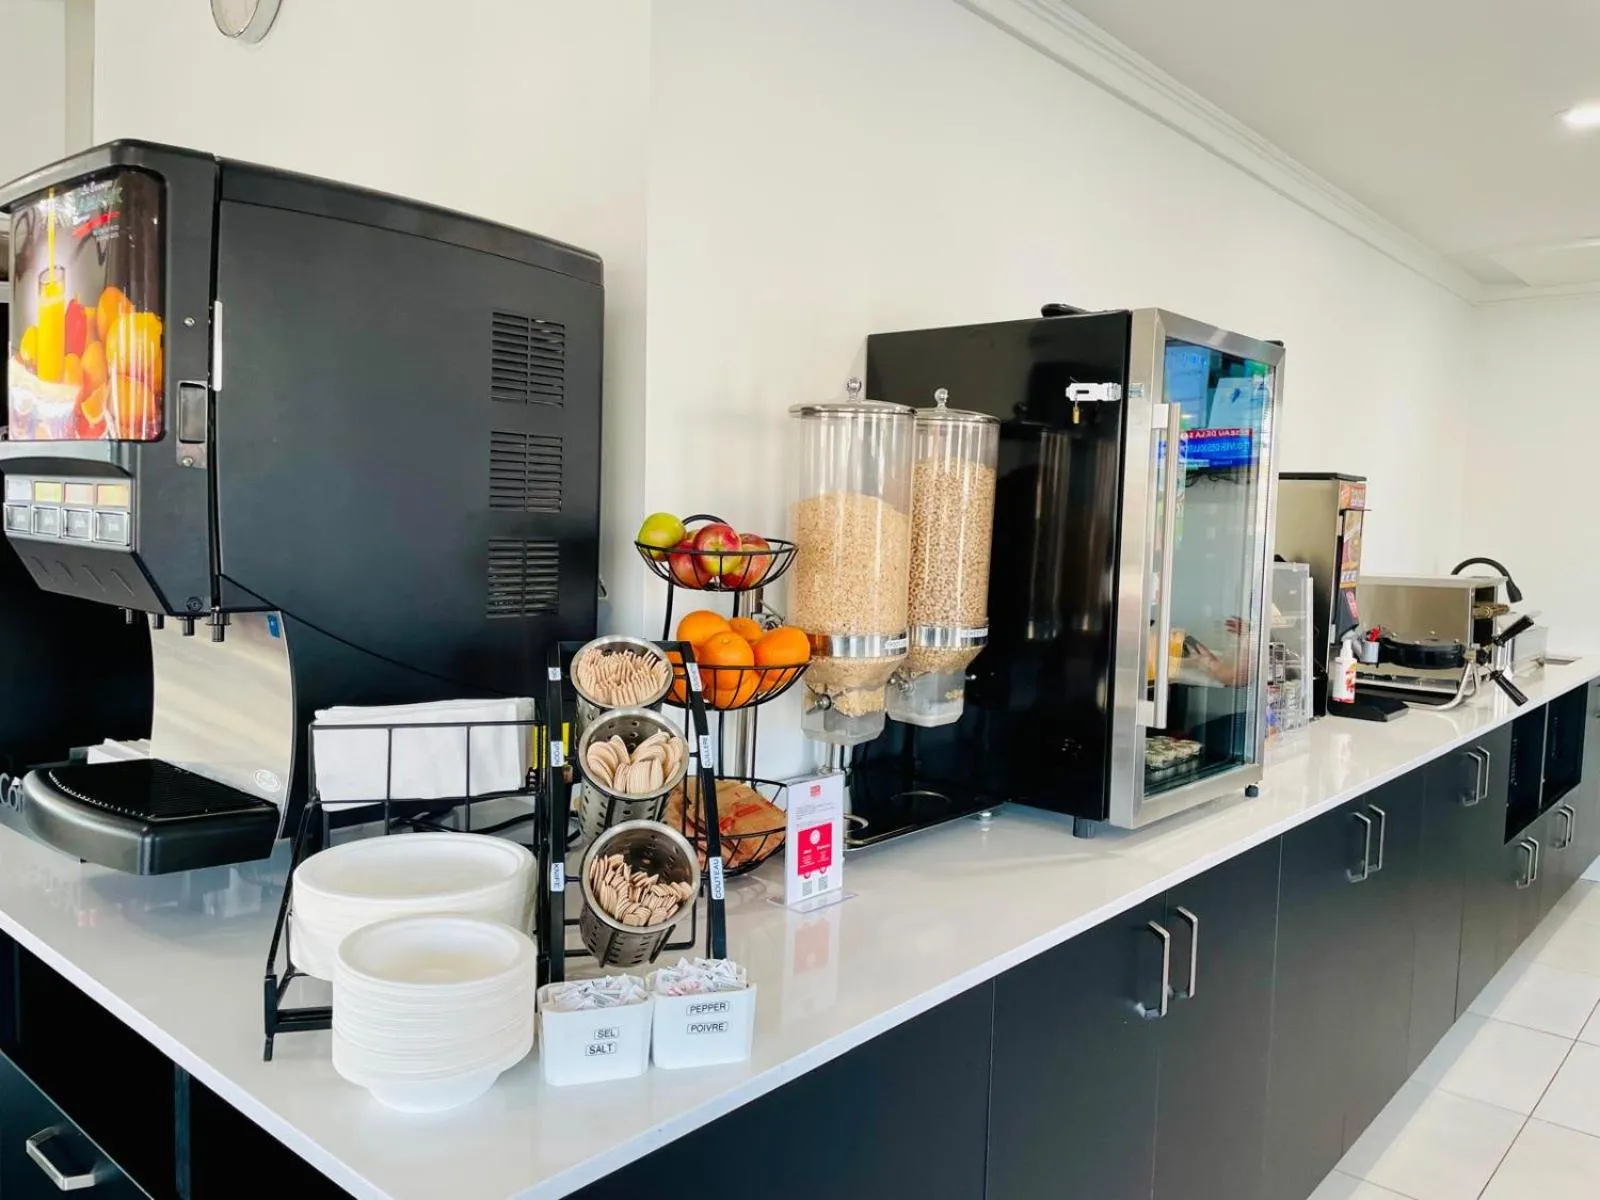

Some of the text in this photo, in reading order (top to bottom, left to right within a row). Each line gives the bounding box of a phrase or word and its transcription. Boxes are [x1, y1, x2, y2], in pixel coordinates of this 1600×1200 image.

[713, 858, 722, 898] COUTEAU
[690, 1002, 726, 1013] PEPPER
[690, 1022, 725, 1033] POIVRE
[597, 1028, 616, 1039] SEL
[589, 1043, 613, 1055] SALT
